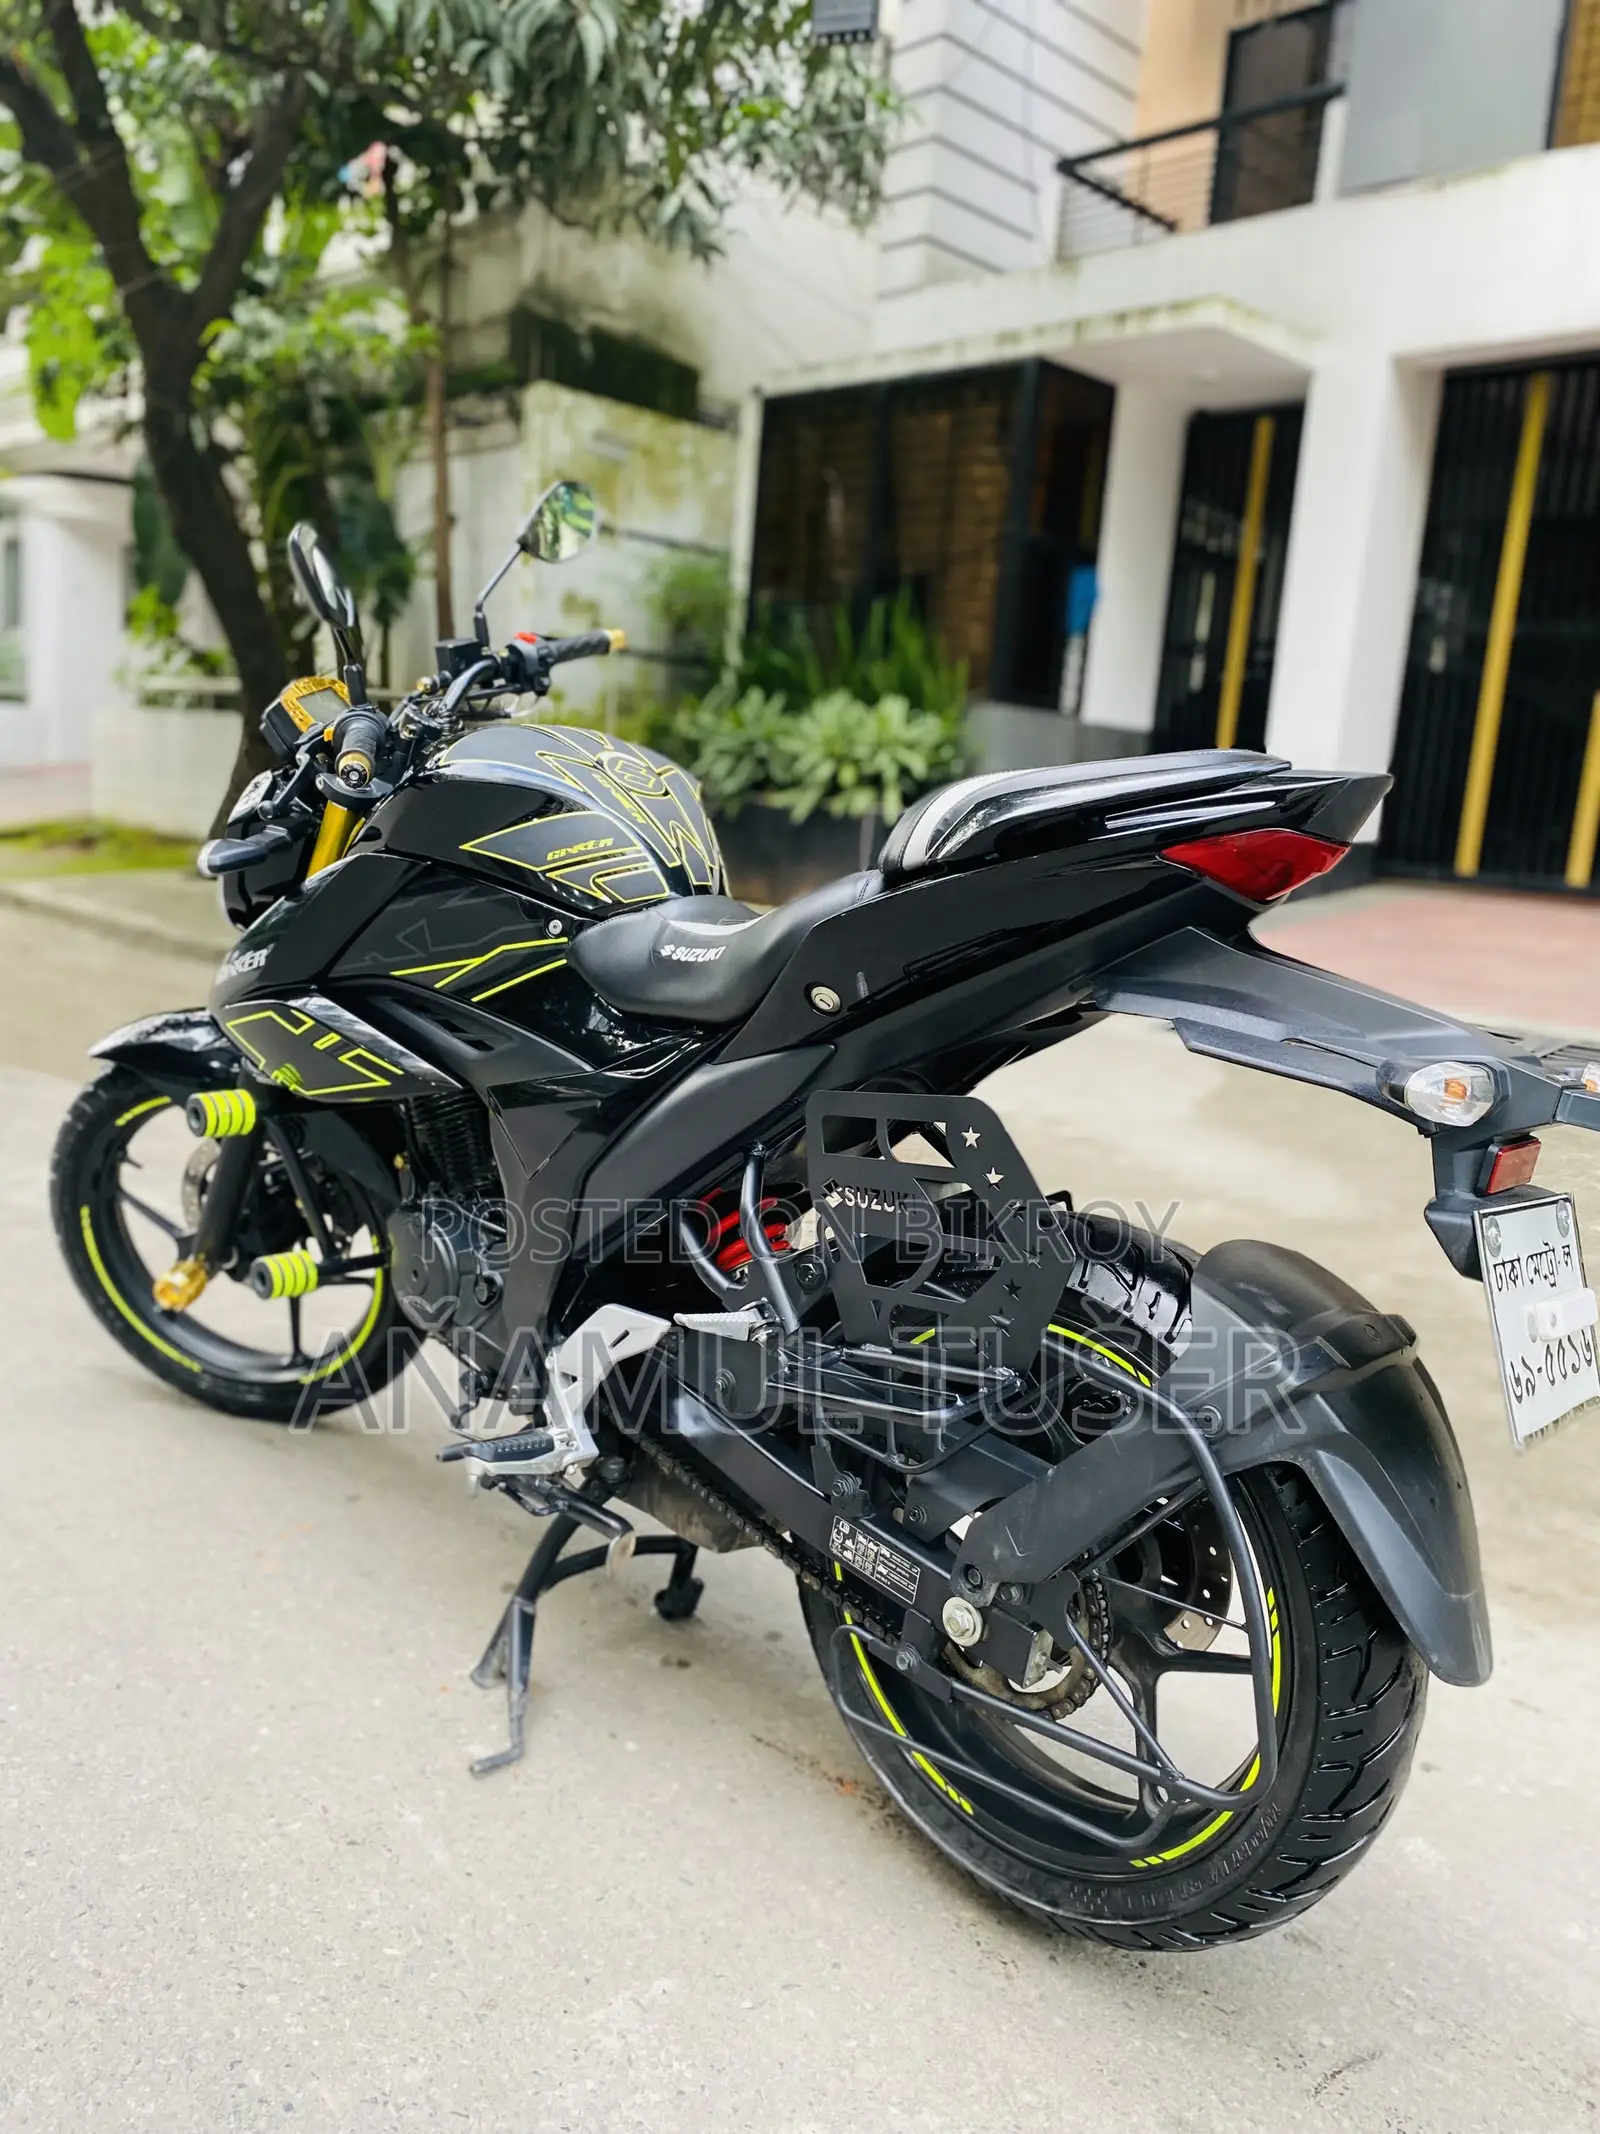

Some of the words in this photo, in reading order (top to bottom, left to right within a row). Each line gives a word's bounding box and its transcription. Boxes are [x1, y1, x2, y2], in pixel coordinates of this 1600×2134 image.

[671, 945, 727, 963] SUZUKI
[844, 1185, 917, 1215] SUZUKI
[1493, 1253, 1524, 1292] ঢাকা
[1509, 1328, 1593, 1404] ৬৯-০০১৬
